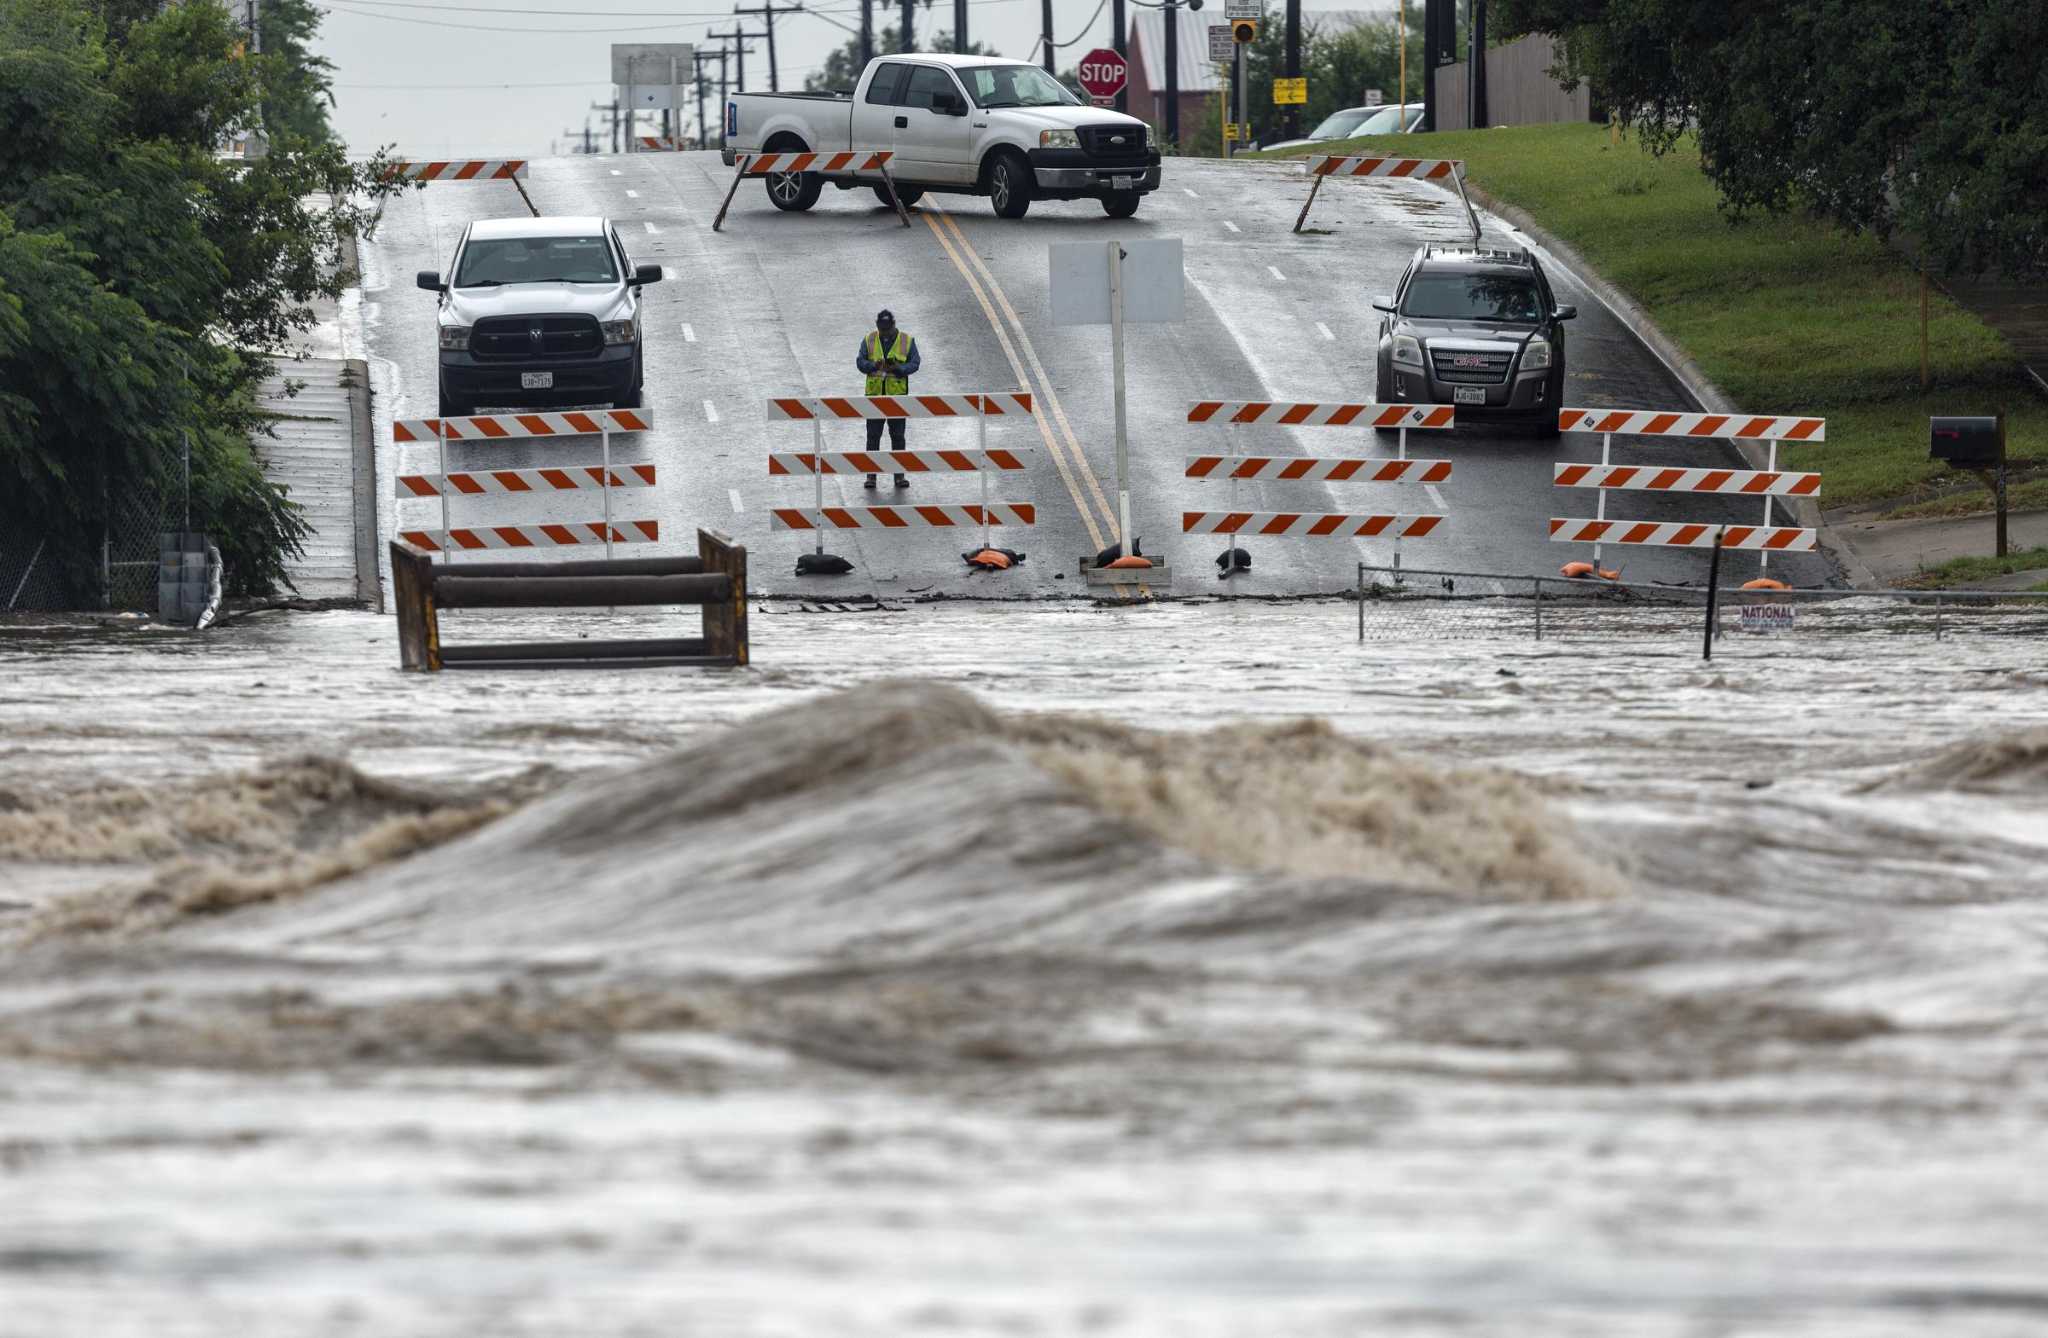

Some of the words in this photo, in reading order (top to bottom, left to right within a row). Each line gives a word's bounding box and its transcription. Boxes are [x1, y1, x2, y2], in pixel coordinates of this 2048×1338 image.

[1081, 63, 1125, 83] STOP
[1454, 357, 1489, 368] GMC
[1742, 606, 1793, 618] NATIONAL
